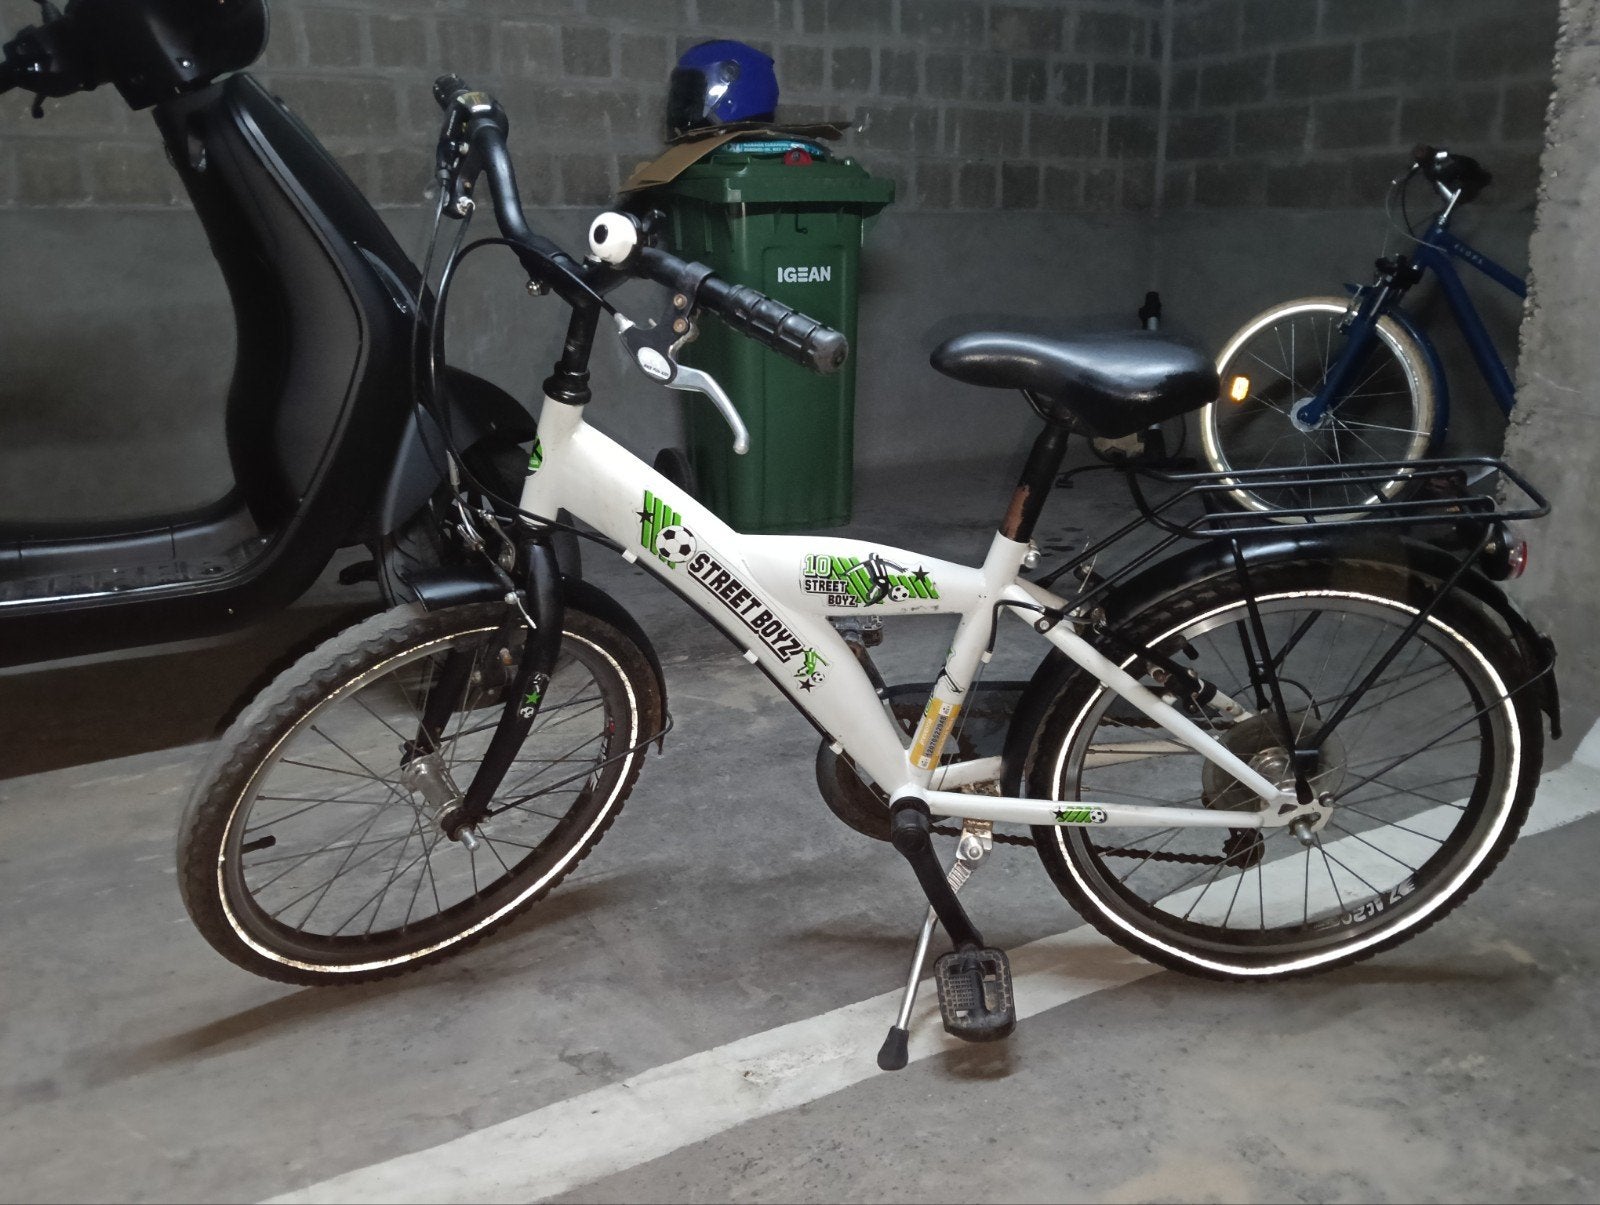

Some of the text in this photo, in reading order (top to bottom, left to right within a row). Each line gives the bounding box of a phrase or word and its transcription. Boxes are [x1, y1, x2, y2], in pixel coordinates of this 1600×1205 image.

[777, 266, 831, 283] IGEAN
[804, 554, 832, 577] 10
[804, 579, 847, 593] STREET
[689, 552, 804, 660] STREET BOYZ
[828, 595, 857, 606] BOYZ
